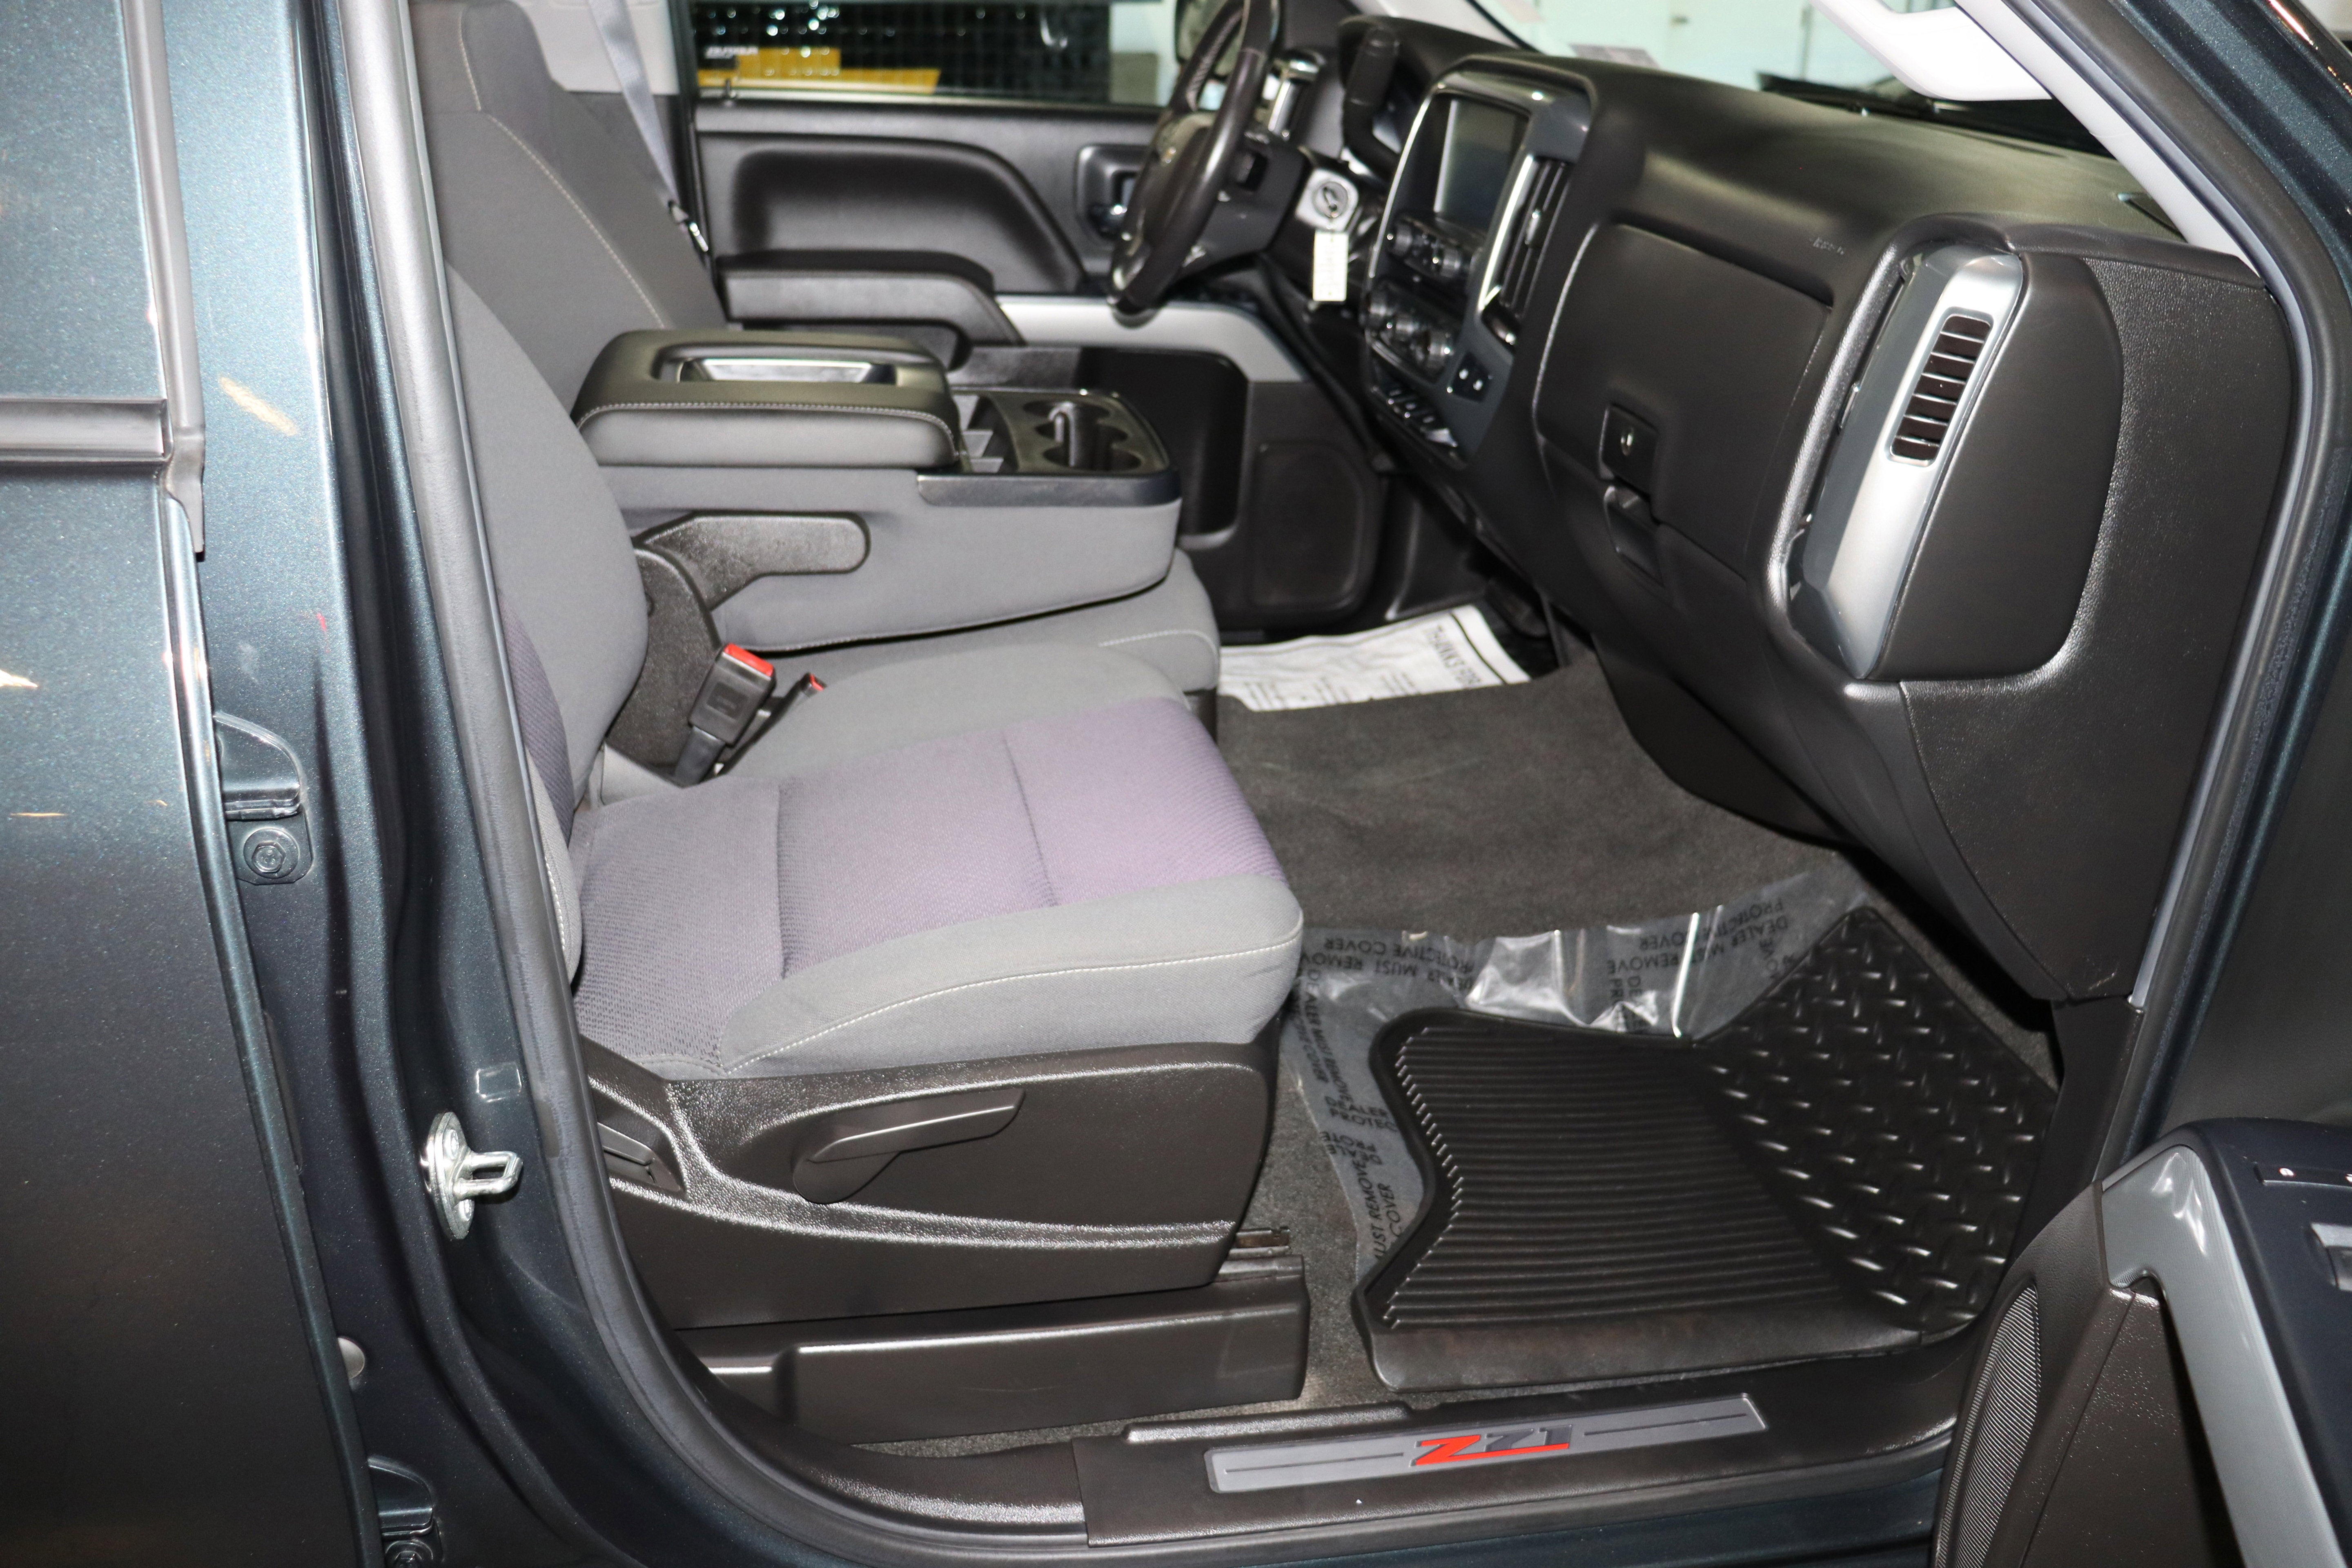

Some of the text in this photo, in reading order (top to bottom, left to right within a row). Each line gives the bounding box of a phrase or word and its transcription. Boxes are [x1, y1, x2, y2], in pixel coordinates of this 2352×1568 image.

[1323, 938, 1386, 955] COVER
[1639, 931, 1698, 951] OVER
[1375, 960, 1419, 977] MUST
[1312, 1028, 1332, 1055] MUST
[1303, 1044, 1329, 1083] COVER
[1352, 1158, 1383, 1220] REMOVE
[1378, 1182, 1403, 1237] COVER
[1409, 1425, 1572, 1467] Z71
